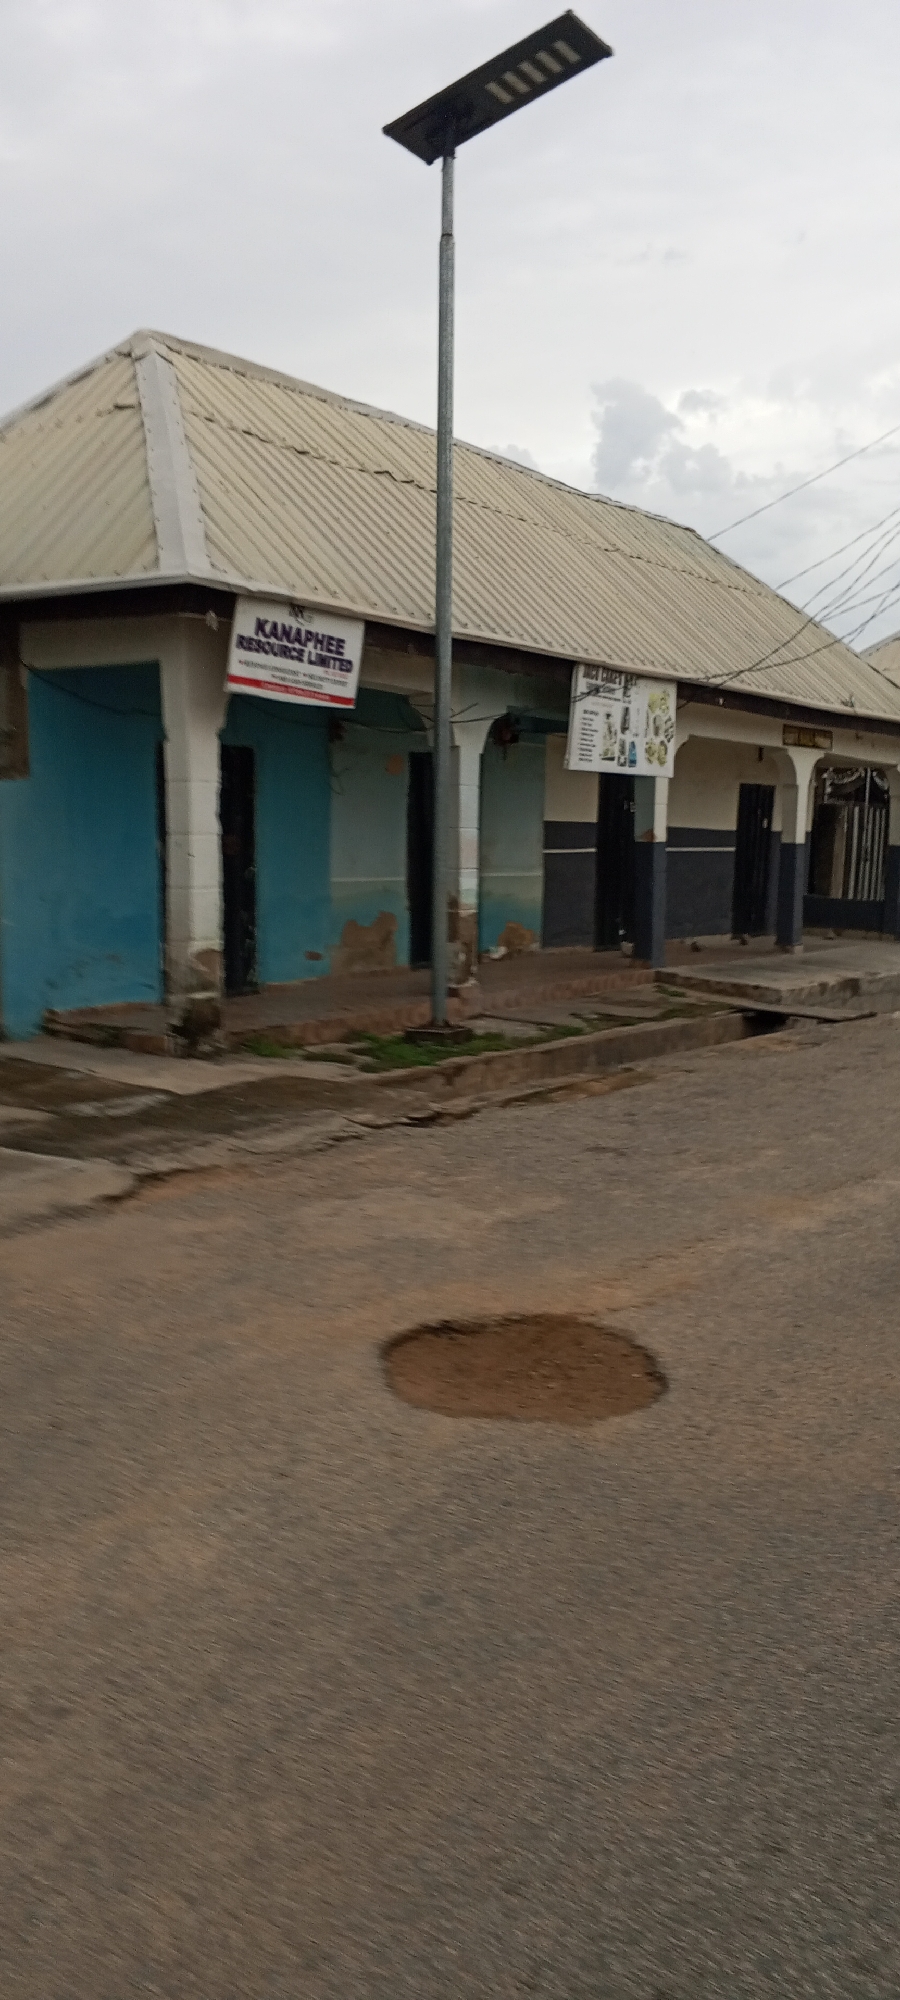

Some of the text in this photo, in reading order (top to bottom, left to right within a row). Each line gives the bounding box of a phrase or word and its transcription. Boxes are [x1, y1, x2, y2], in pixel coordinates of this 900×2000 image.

[237, 634, 305, 663] RESOURCE
[307, 650, 354, 673] LIMITED
[255, 617, 346, 656] KANAPHEE
